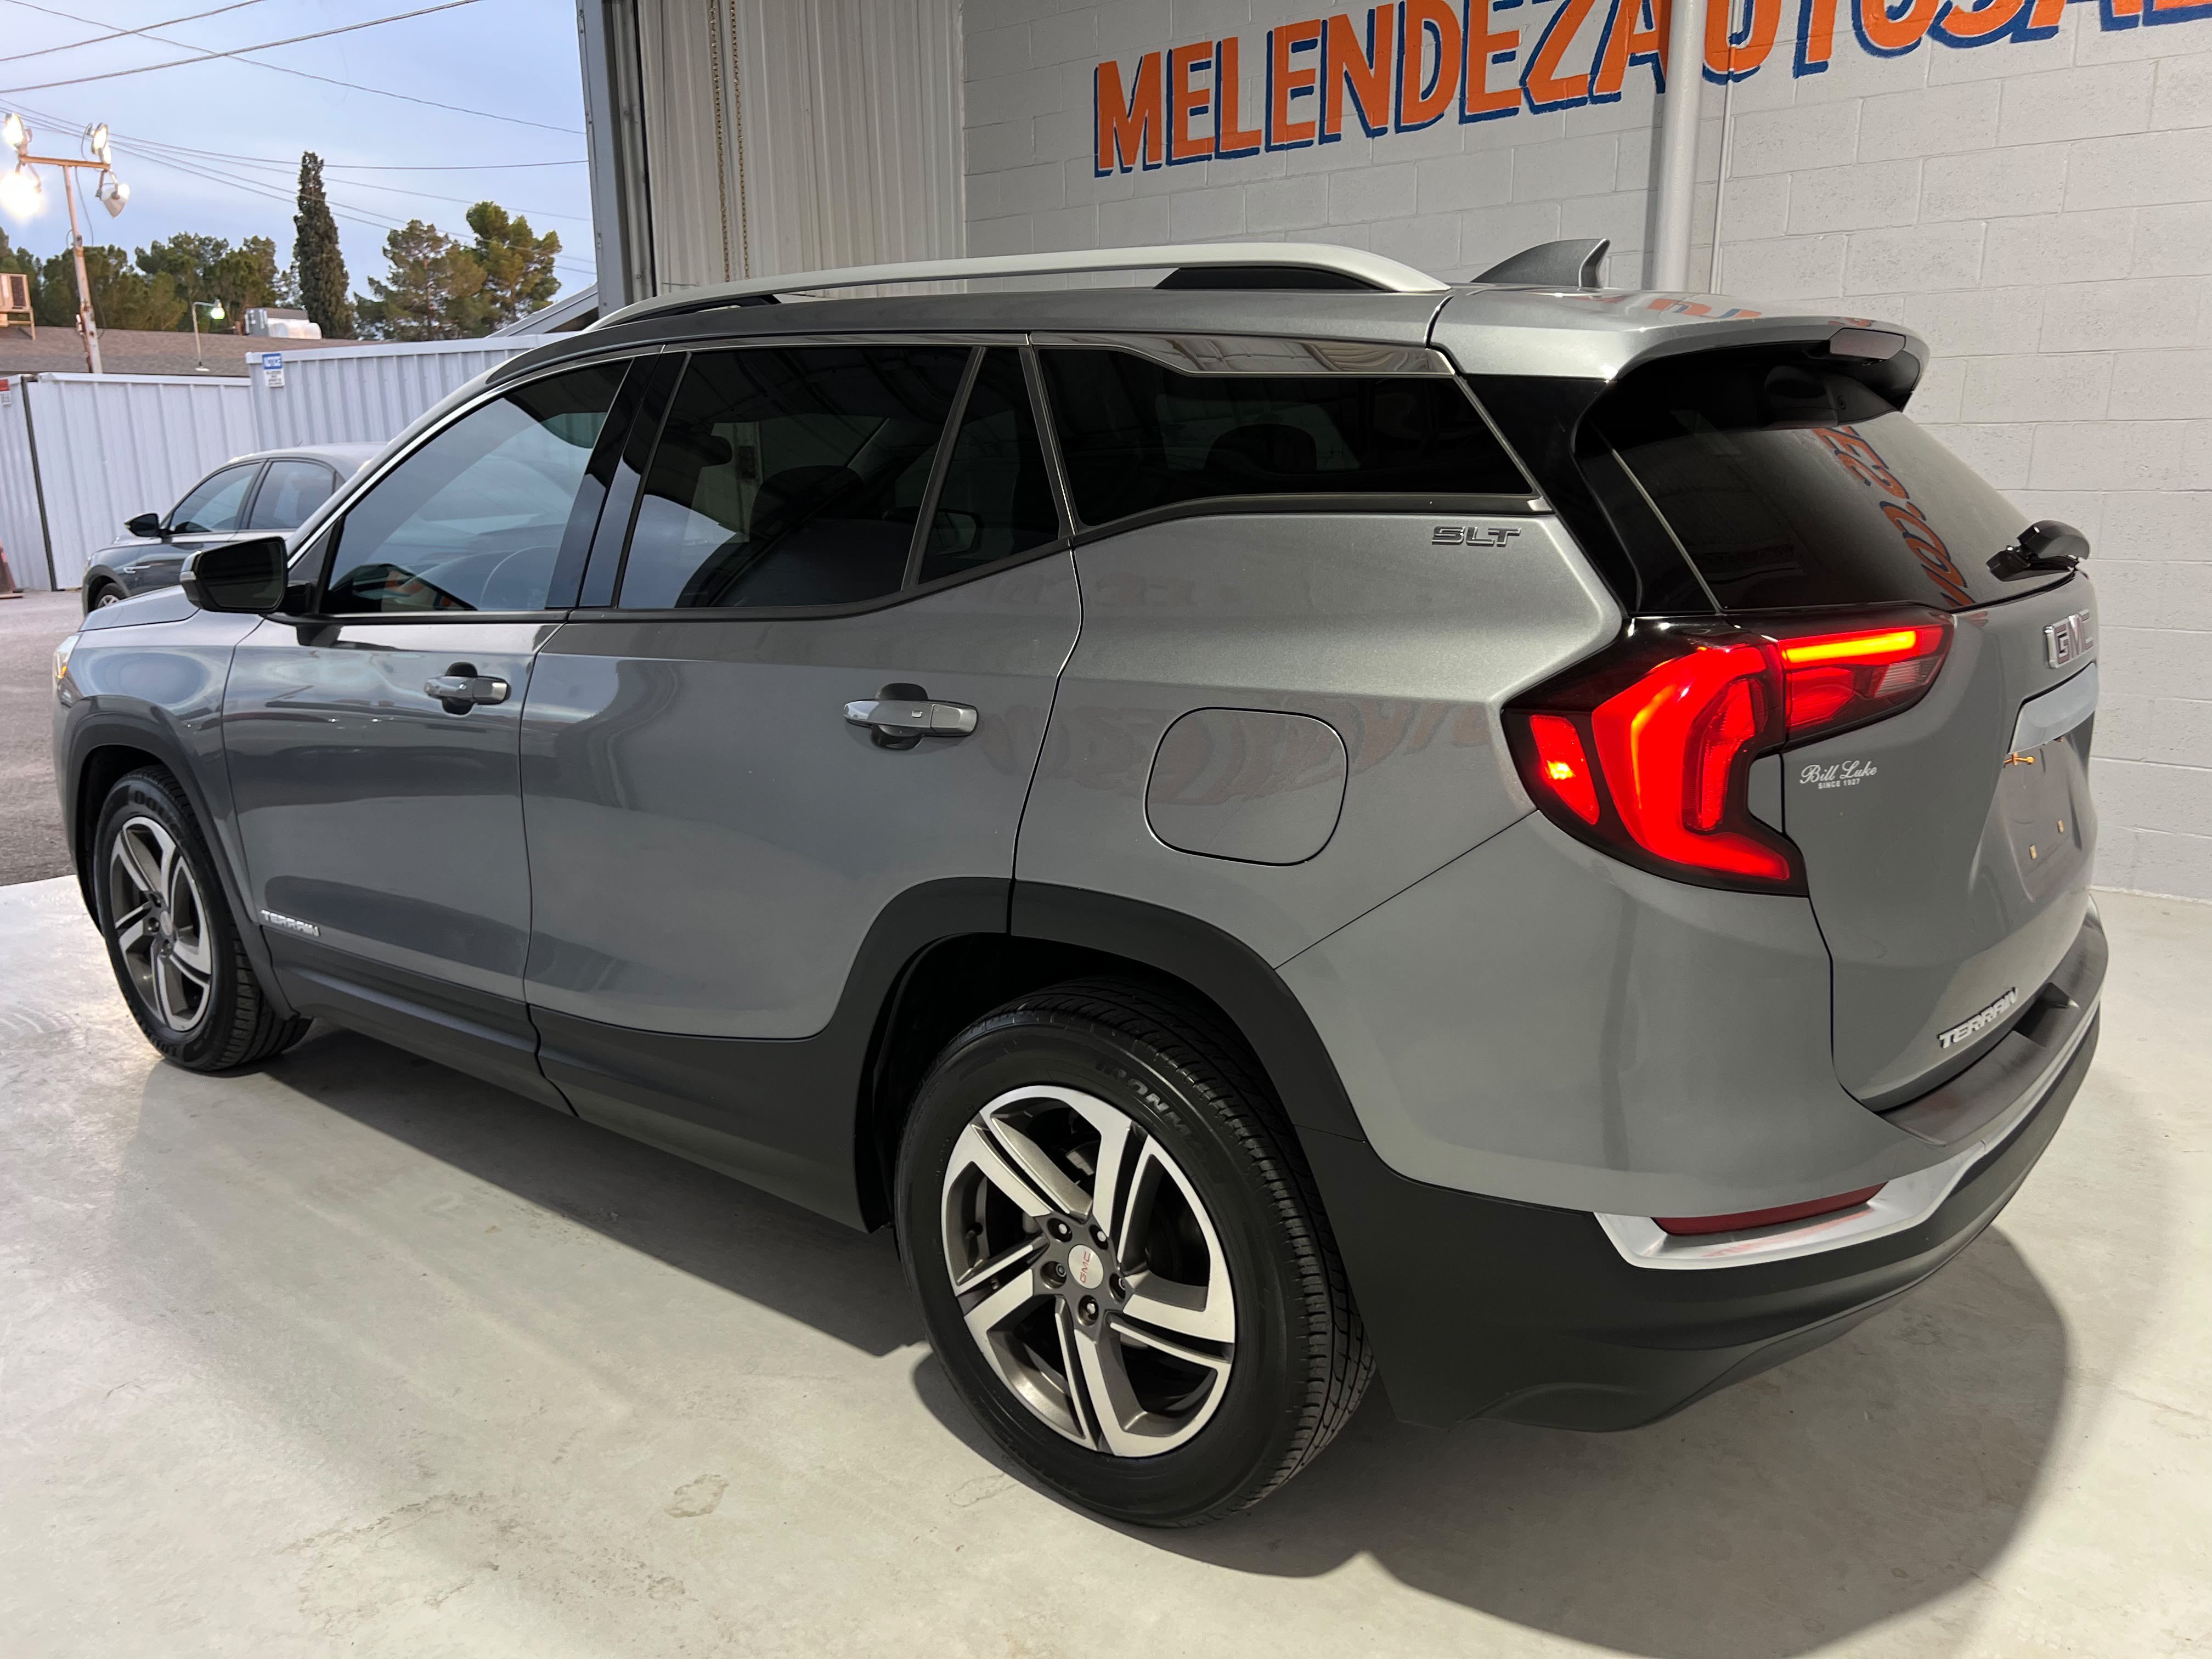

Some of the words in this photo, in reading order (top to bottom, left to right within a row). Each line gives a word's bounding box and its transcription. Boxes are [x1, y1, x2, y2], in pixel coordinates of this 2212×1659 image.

[1431, 526, 1521, 547] SLT
[2044, 609, 2095, 668] GMC
[1799, 764, 1839, 784] Bill
[1839, 760, 1877, 780] Luke
[1818, 780, 1841, 789] SINCE
[1843, 778, 1861, 786] 1927
[261, 909, 321, 937] TERRAIN
[1937, 986, 2019, 1049] TERRAIN
[1080, 1250, 1091, 1284] GMC
